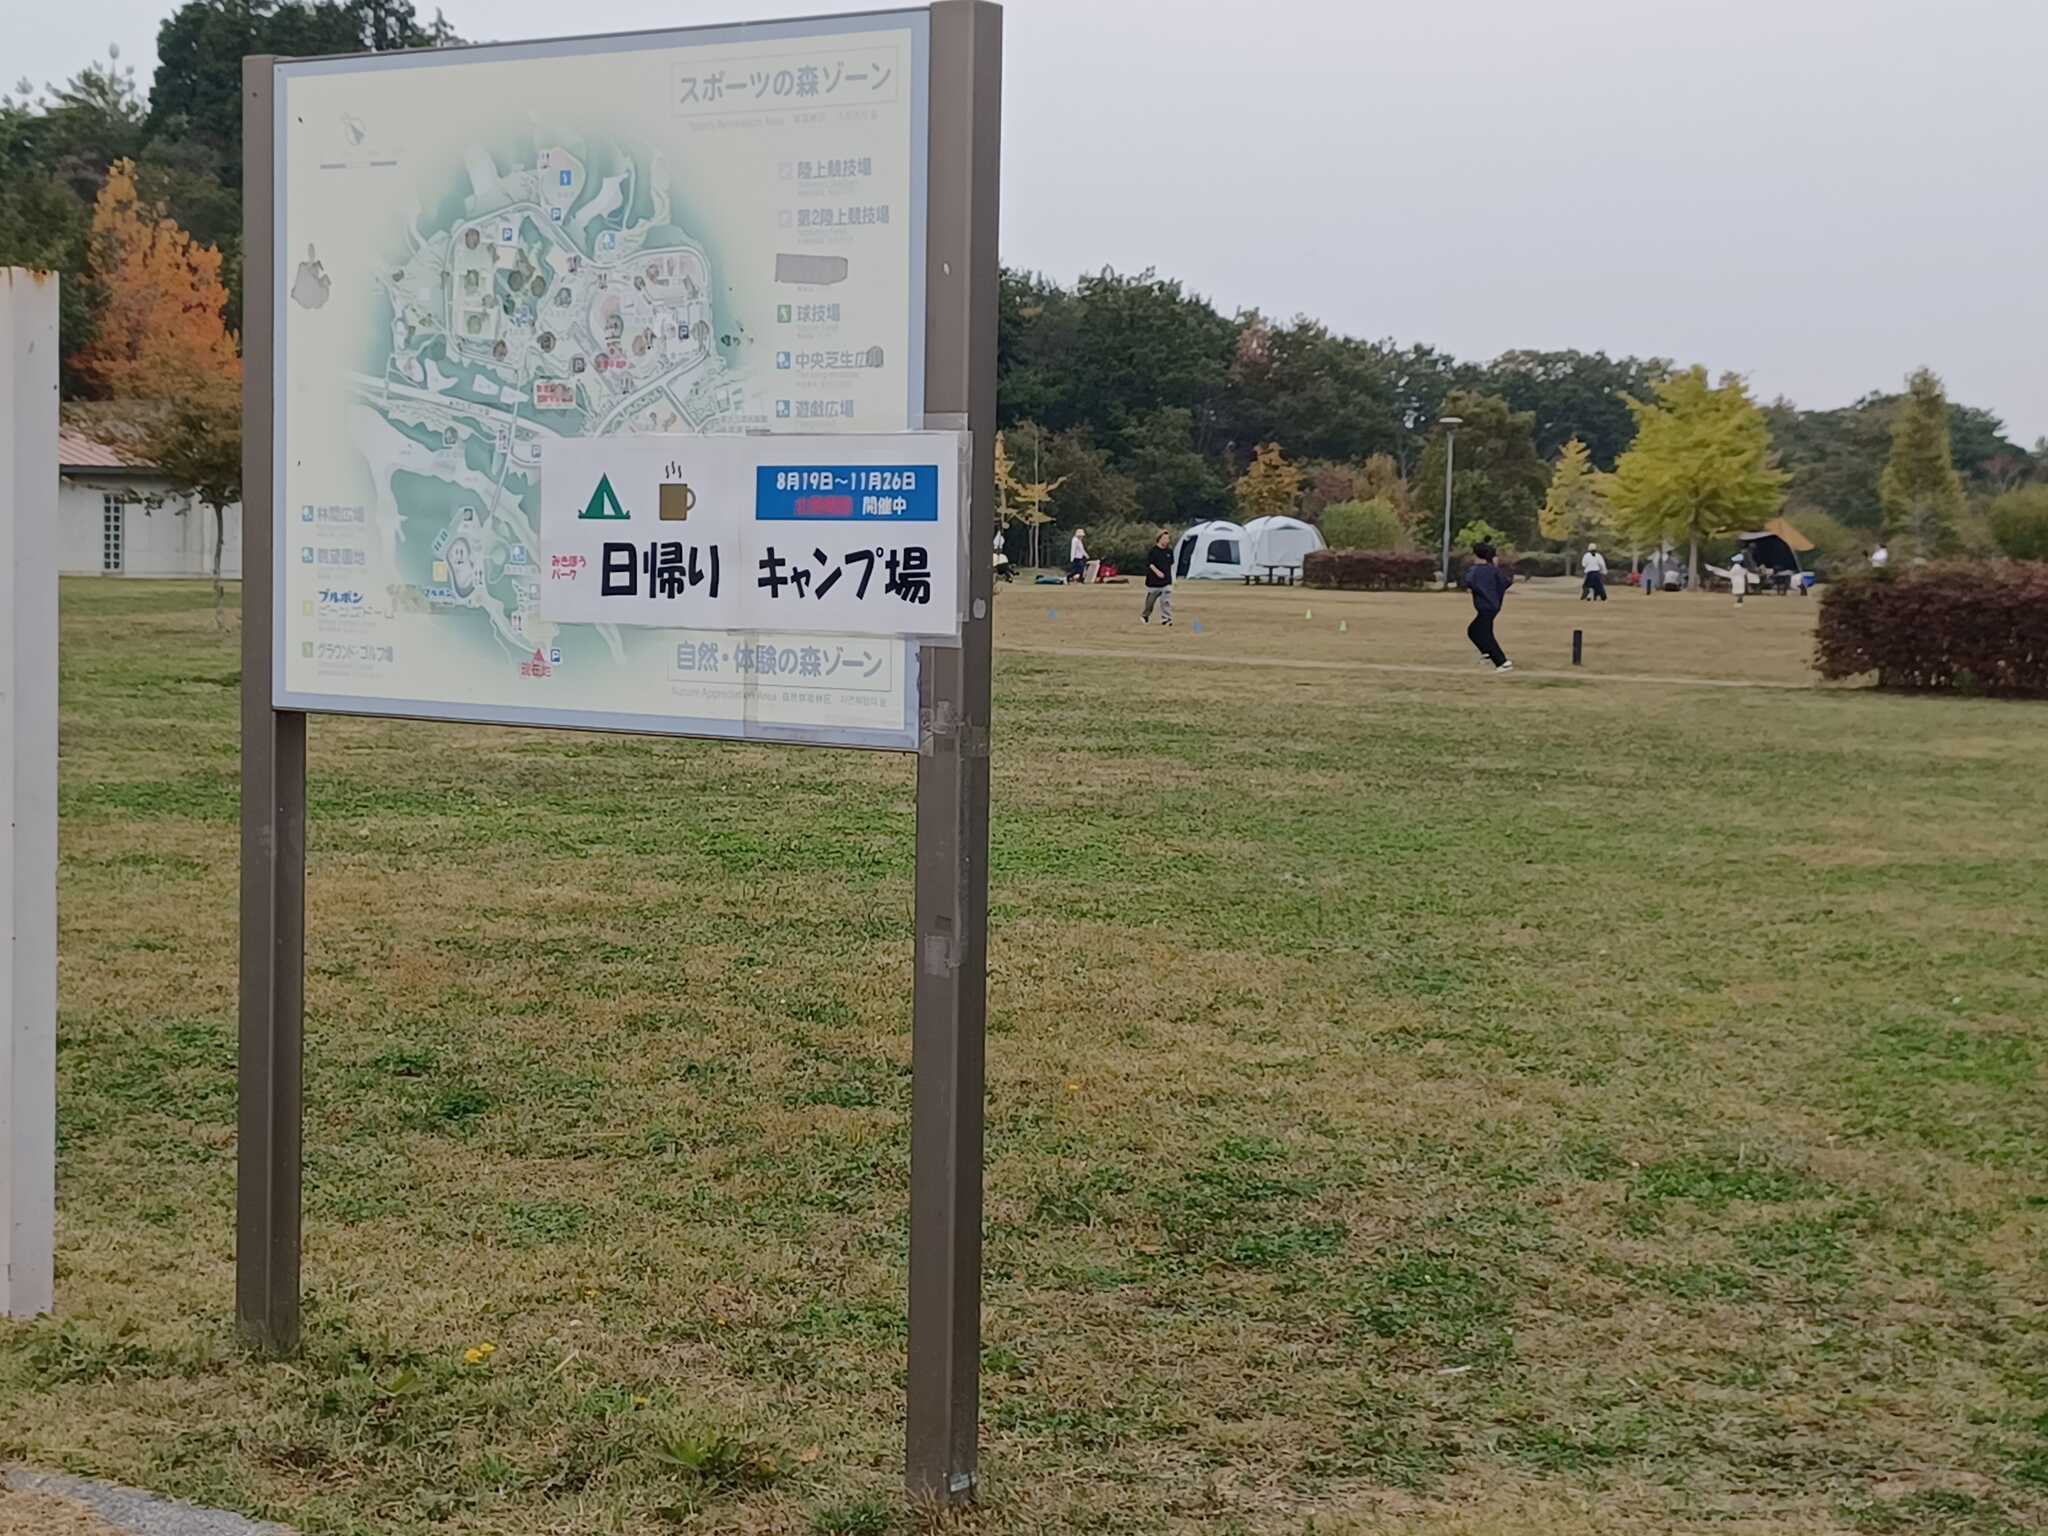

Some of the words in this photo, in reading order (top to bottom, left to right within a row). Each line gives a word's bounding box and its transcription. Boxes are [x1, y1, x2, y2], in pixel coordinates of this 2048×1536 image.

[680, 61, 892, 104] スポーツの森ゾーン
[797, 157, 872, 180] 陸上競技場
[797, 205, 890, 227] 第2陸上競技場
[796, 303, 841, 323] 球技場
[795, 350, 877, 369] 中央芝生広
[862, 496, 907, 515] 開催中
[601, 541, 720, 599] 日帰り
[757, 547, 931, 605] キャンプ場
[676, 640, 883, 678] 自然・体験の森ゾーン
